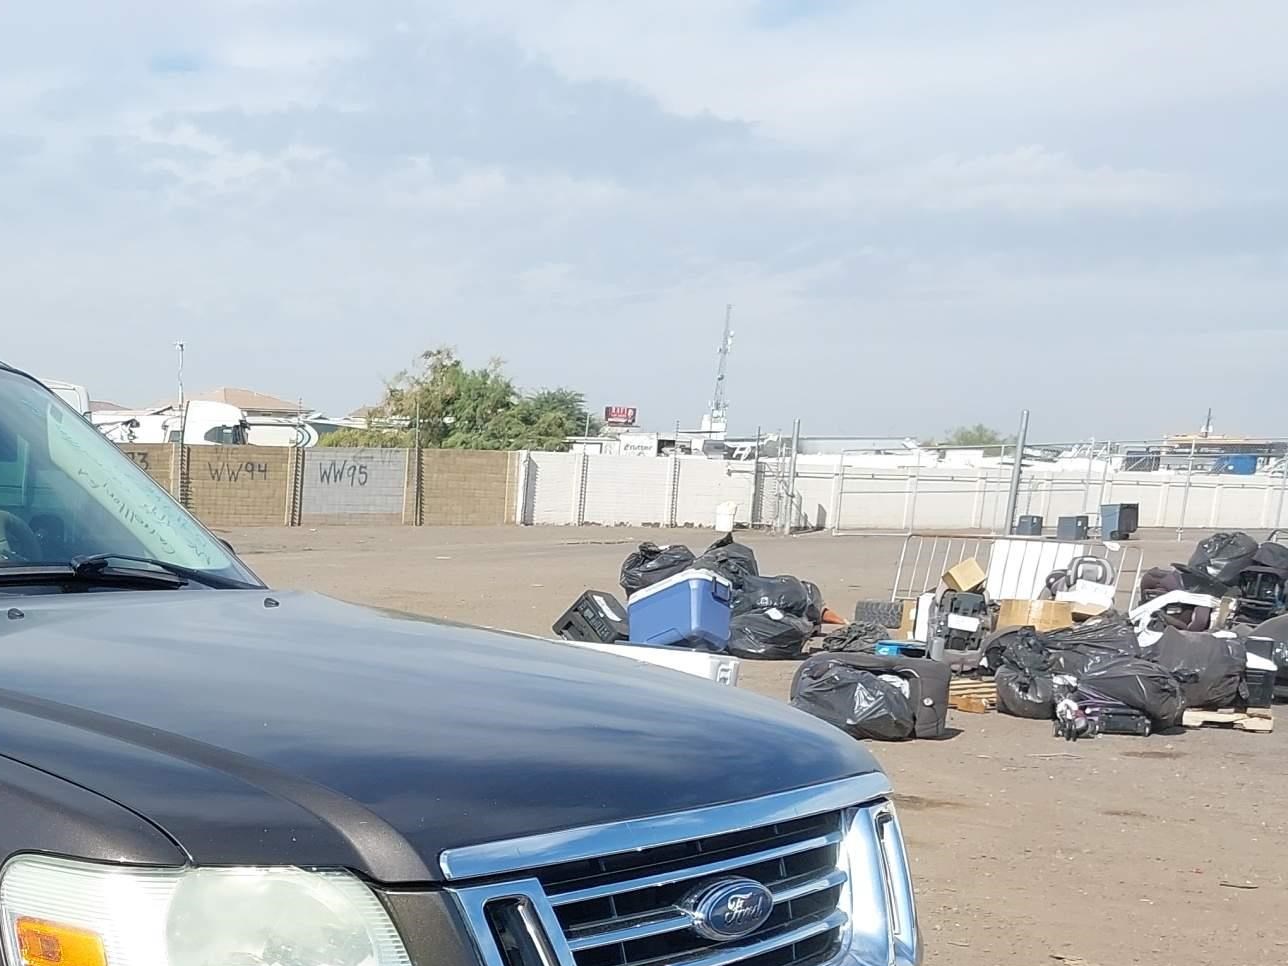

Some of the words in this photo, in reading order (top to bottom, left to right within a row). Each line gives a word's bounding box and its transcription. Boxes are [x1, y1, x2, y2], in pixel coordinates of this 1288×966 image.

[207, 461, 268, 482] WW94
[319, 460, 368, 487] WW95
[724, 891, 763, 926] Ford
